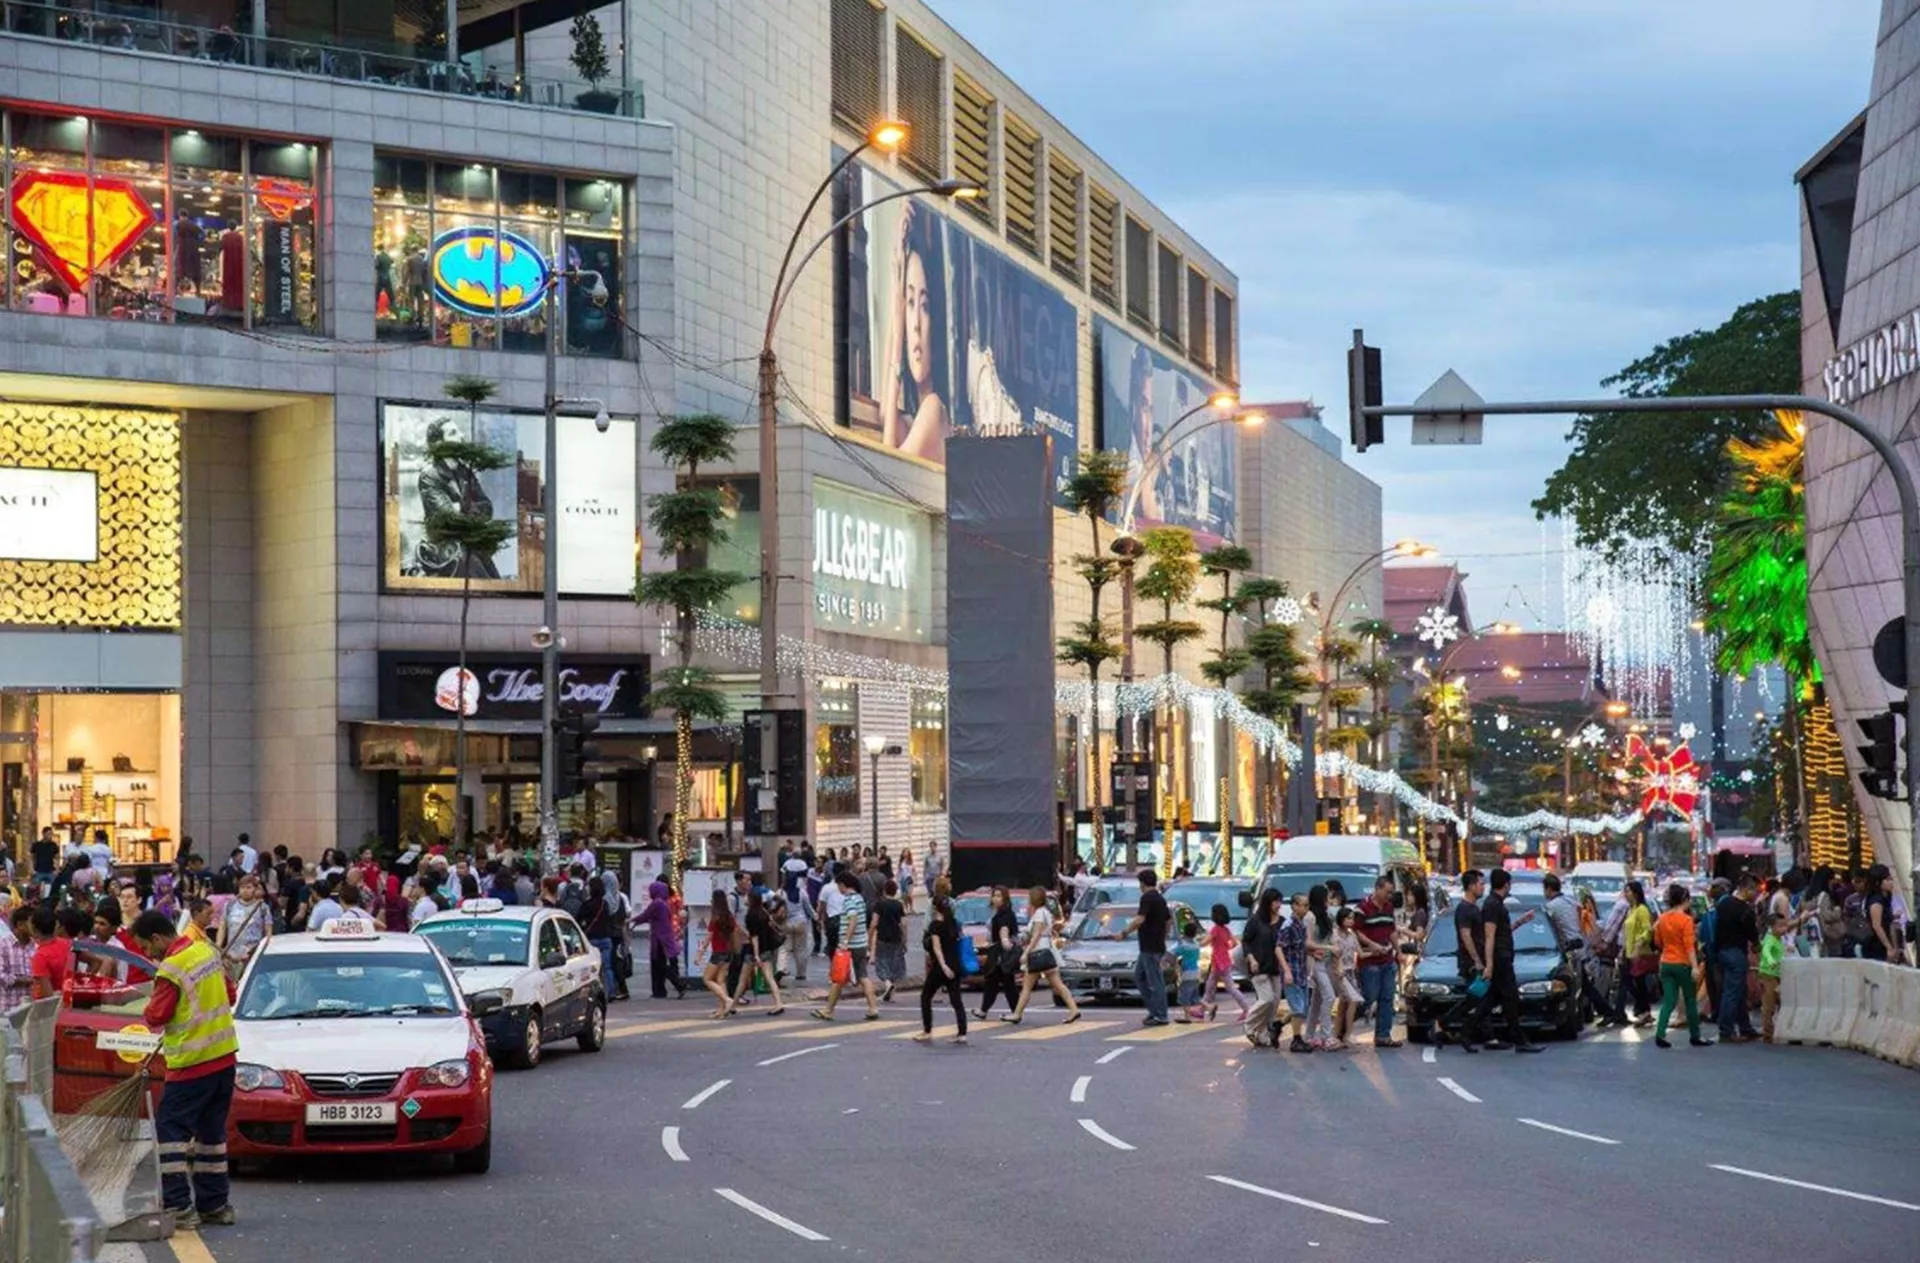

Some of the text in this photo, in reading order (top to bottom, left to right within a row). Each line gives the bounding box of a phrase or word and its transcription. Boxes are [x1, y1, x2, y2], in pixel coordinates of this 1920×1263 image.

[280, 226, 292, 315] MAN OF STEEL
[1824, 311, 1920, 404] SEPHORA
[817, 593, 857, 619] SINCE
[486, 668, 545, 701] The
[320, 1106, 383, 1119] HBB 3123
